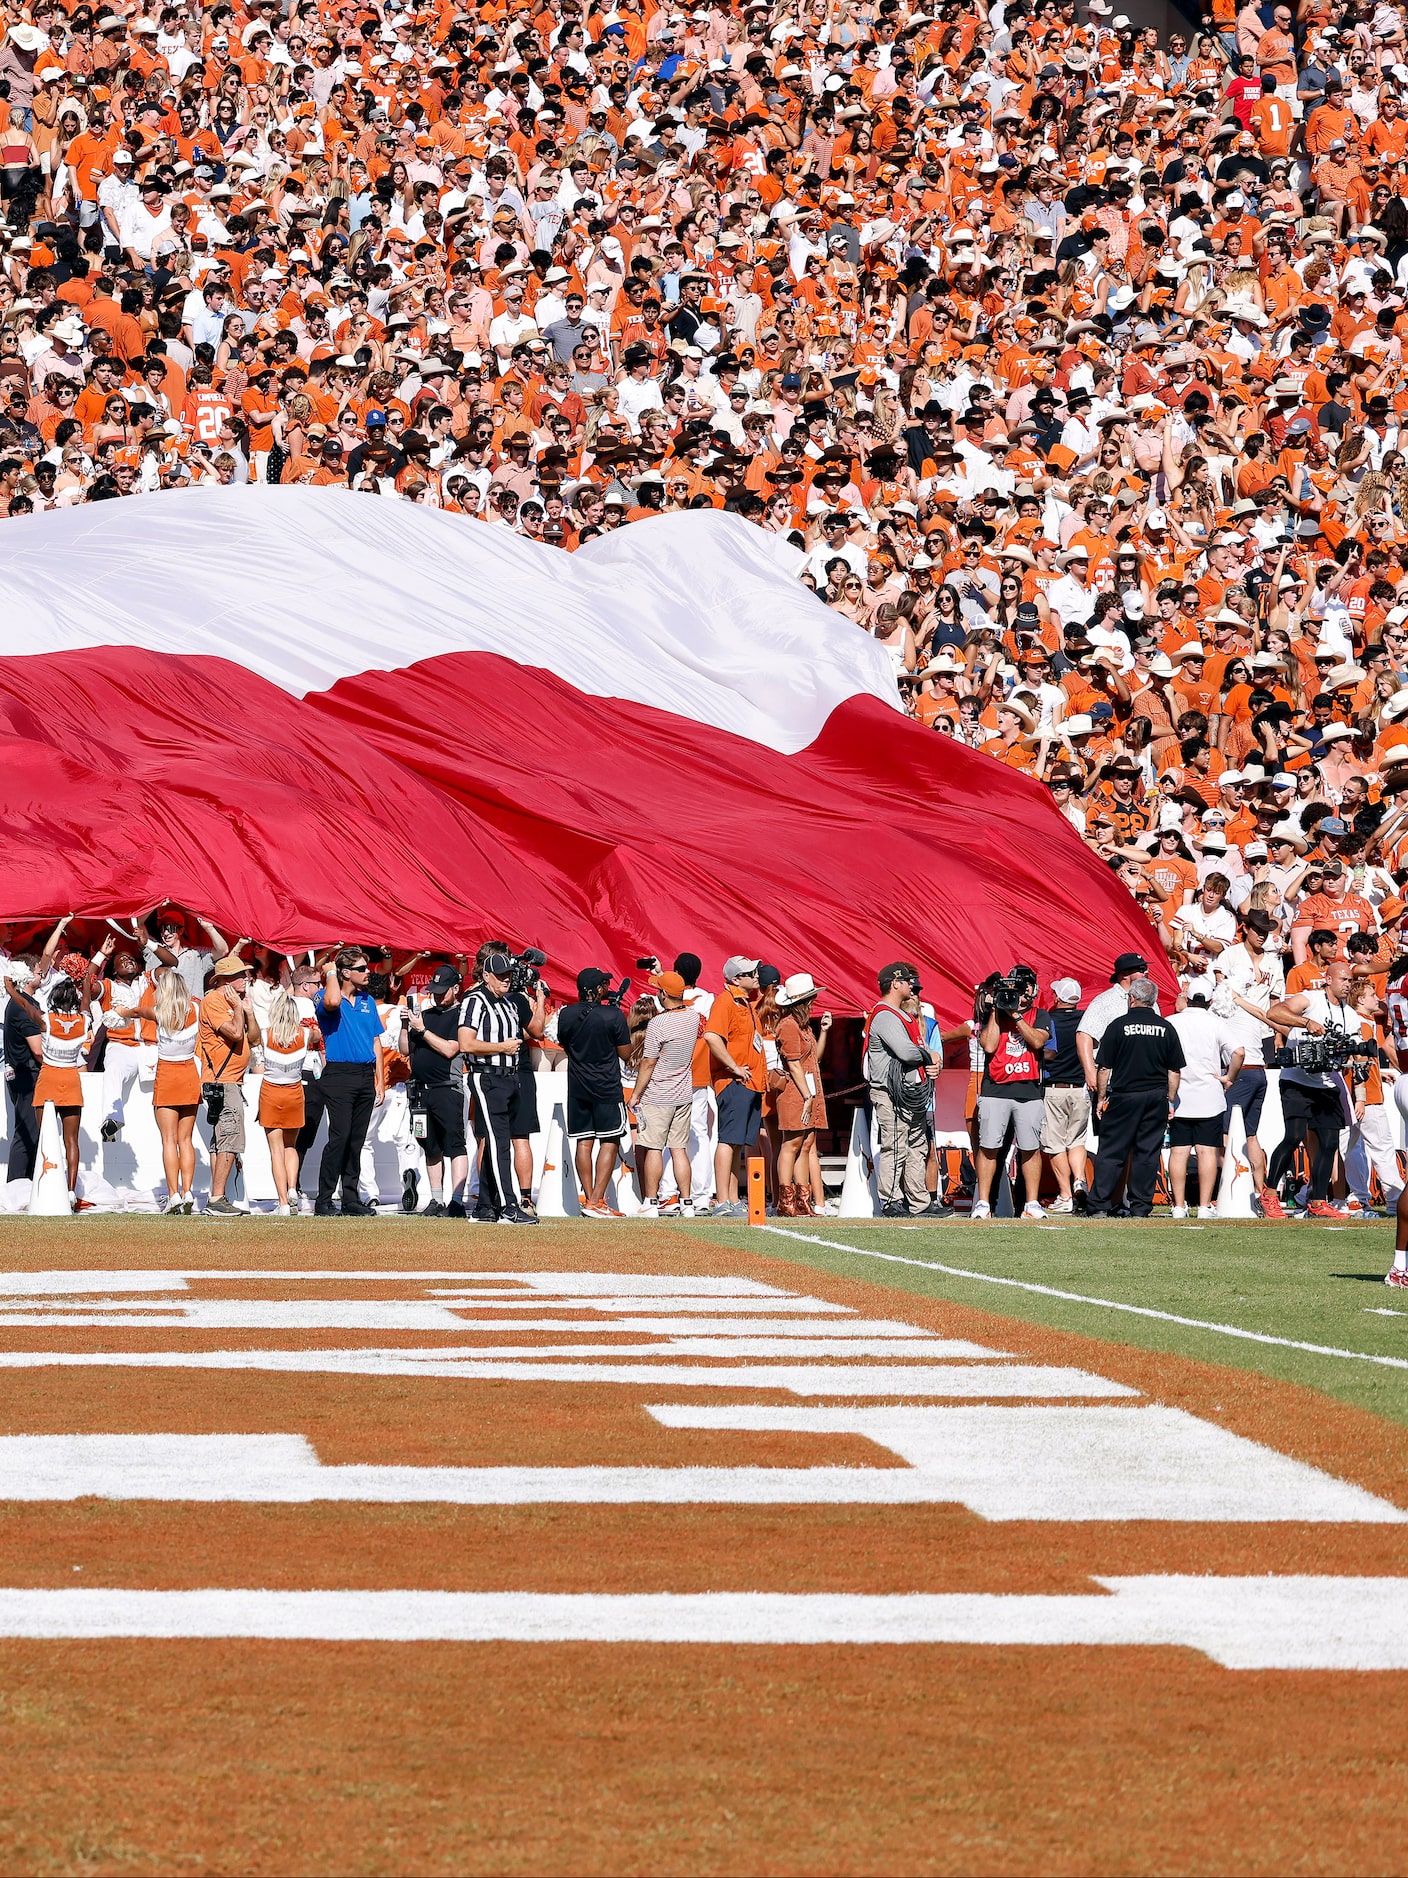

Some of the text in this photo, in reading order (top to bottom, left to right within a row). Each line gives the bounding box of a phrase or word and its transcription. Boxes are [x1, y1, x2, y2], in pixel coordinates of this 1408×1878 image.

[1269, 104, 1282, 131] 1
[548, 213, 562, 224] TEX
[196, 392, 227, 402] CAMPBELL
[196, 406, 230, 440] 20
[1347, 597, 1365, 609] 20
[1331, 909, 1360, 921] TEXAS
[1124, 1024, 1166, 1037] SECURITY
